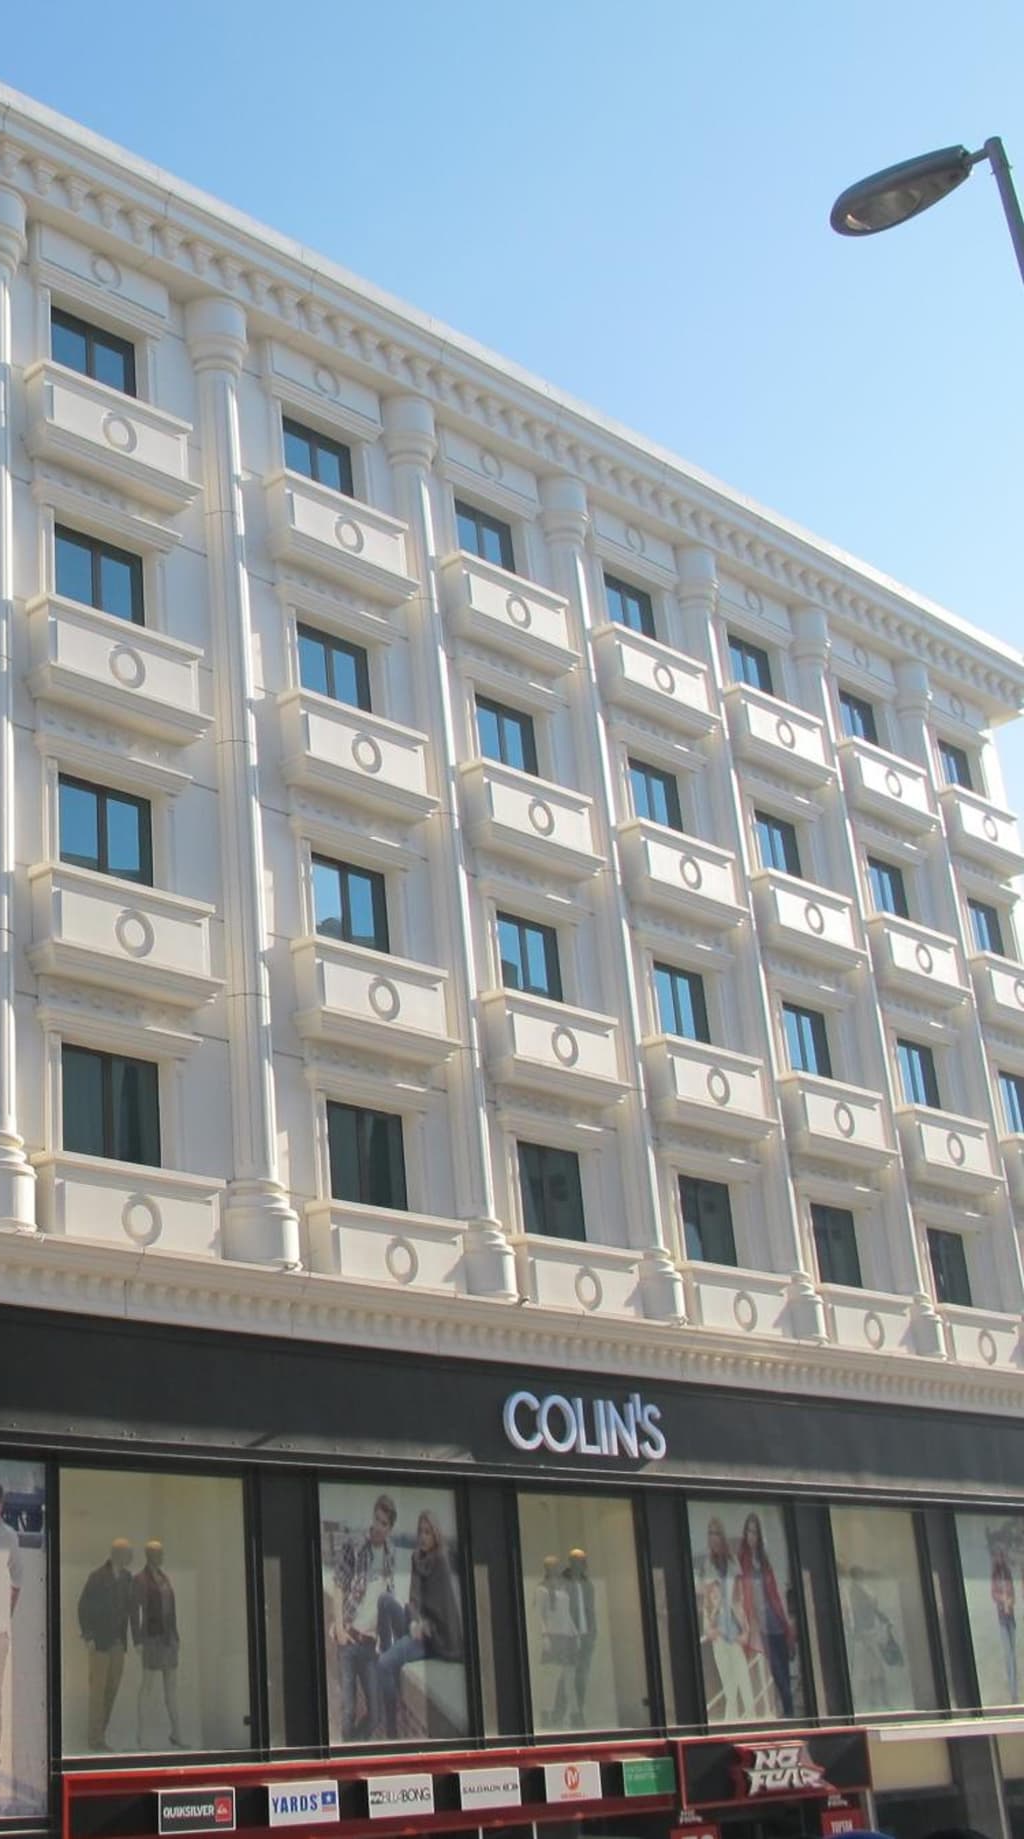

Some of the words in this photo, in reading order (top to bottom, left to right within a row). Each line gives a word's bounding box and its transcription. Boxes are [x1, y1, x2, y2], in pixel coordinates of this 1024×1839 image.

[503, 1391, 666, 1460] COLIN'S
[744, 1767, 824, 1796] FEAR
[163, 1804, 215, 1819] QUIKSILVER
[271, 1794, 319, 1814] YARDS
